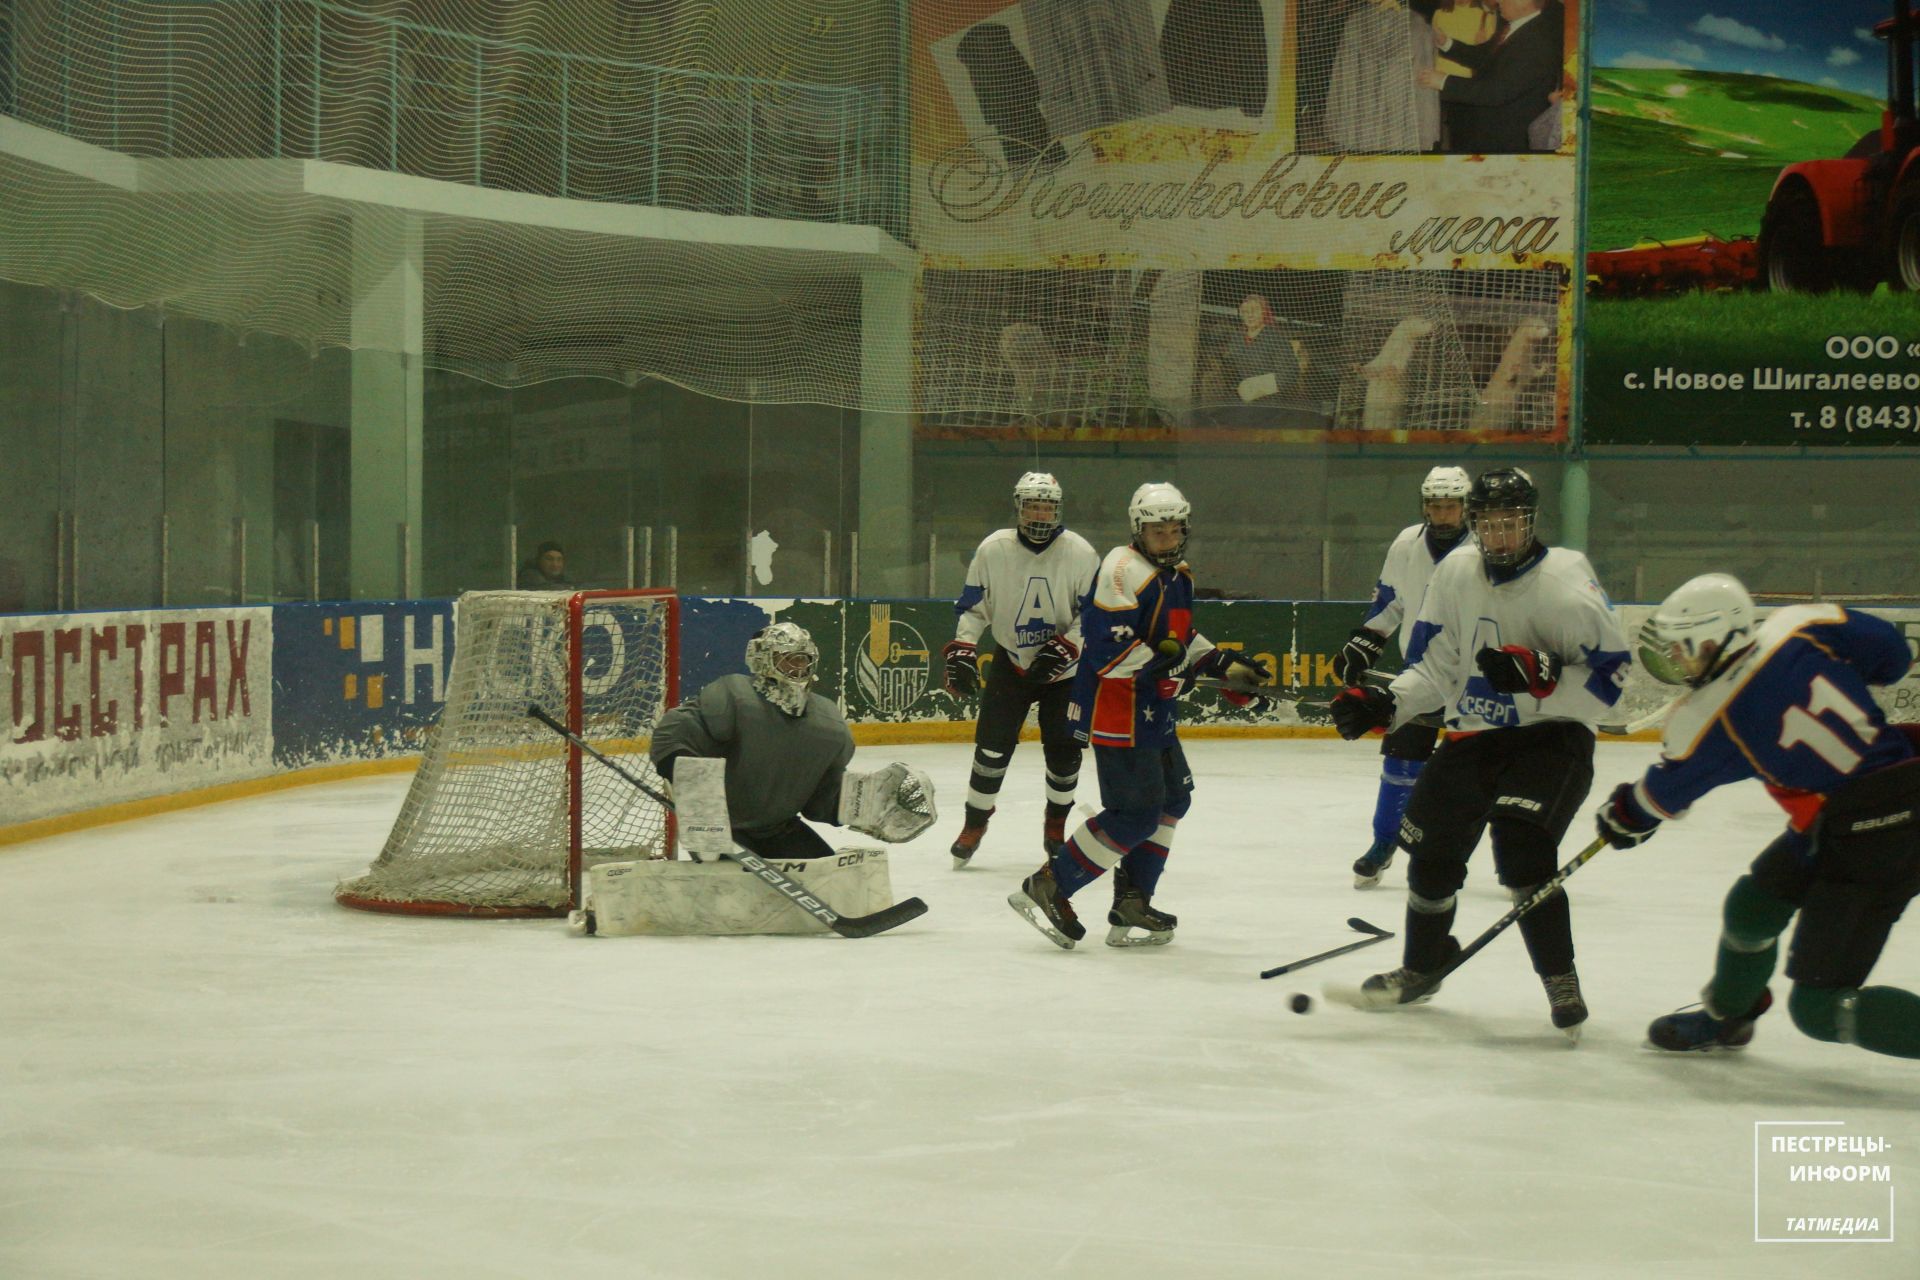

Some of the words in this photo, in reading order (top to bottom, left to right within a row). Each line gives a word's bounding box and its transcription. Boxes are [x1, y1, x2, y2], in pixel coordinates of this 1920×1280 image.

[1389, 212, 1561, 255] меха
[1825, 335, 1899, 359] ООО
[1623, 373, 1645, 390] с.
[1653, 367, 1744, 390] Новое
[1753, 367, 1920, 391] Шигалеево
[1791, 411, 1811, 428] т.
[1819, 405, 1837, 429] 8
[1845, 405, 1920, 432] (843)
[1015, 627, 1056, 648] ЙСБЕР
[1351, 635, 1384, 656] BAU
[405, 609, 626, 704] НСКО
[0, 618, 250, 745] ОССТРАХ
[1459, 690, 1515, 724] СБЕРГ
[1778, 674, 1880, 775] 11
[837, 852, 864, 867] CCM
[740, 856, 838, 926] BAUER
